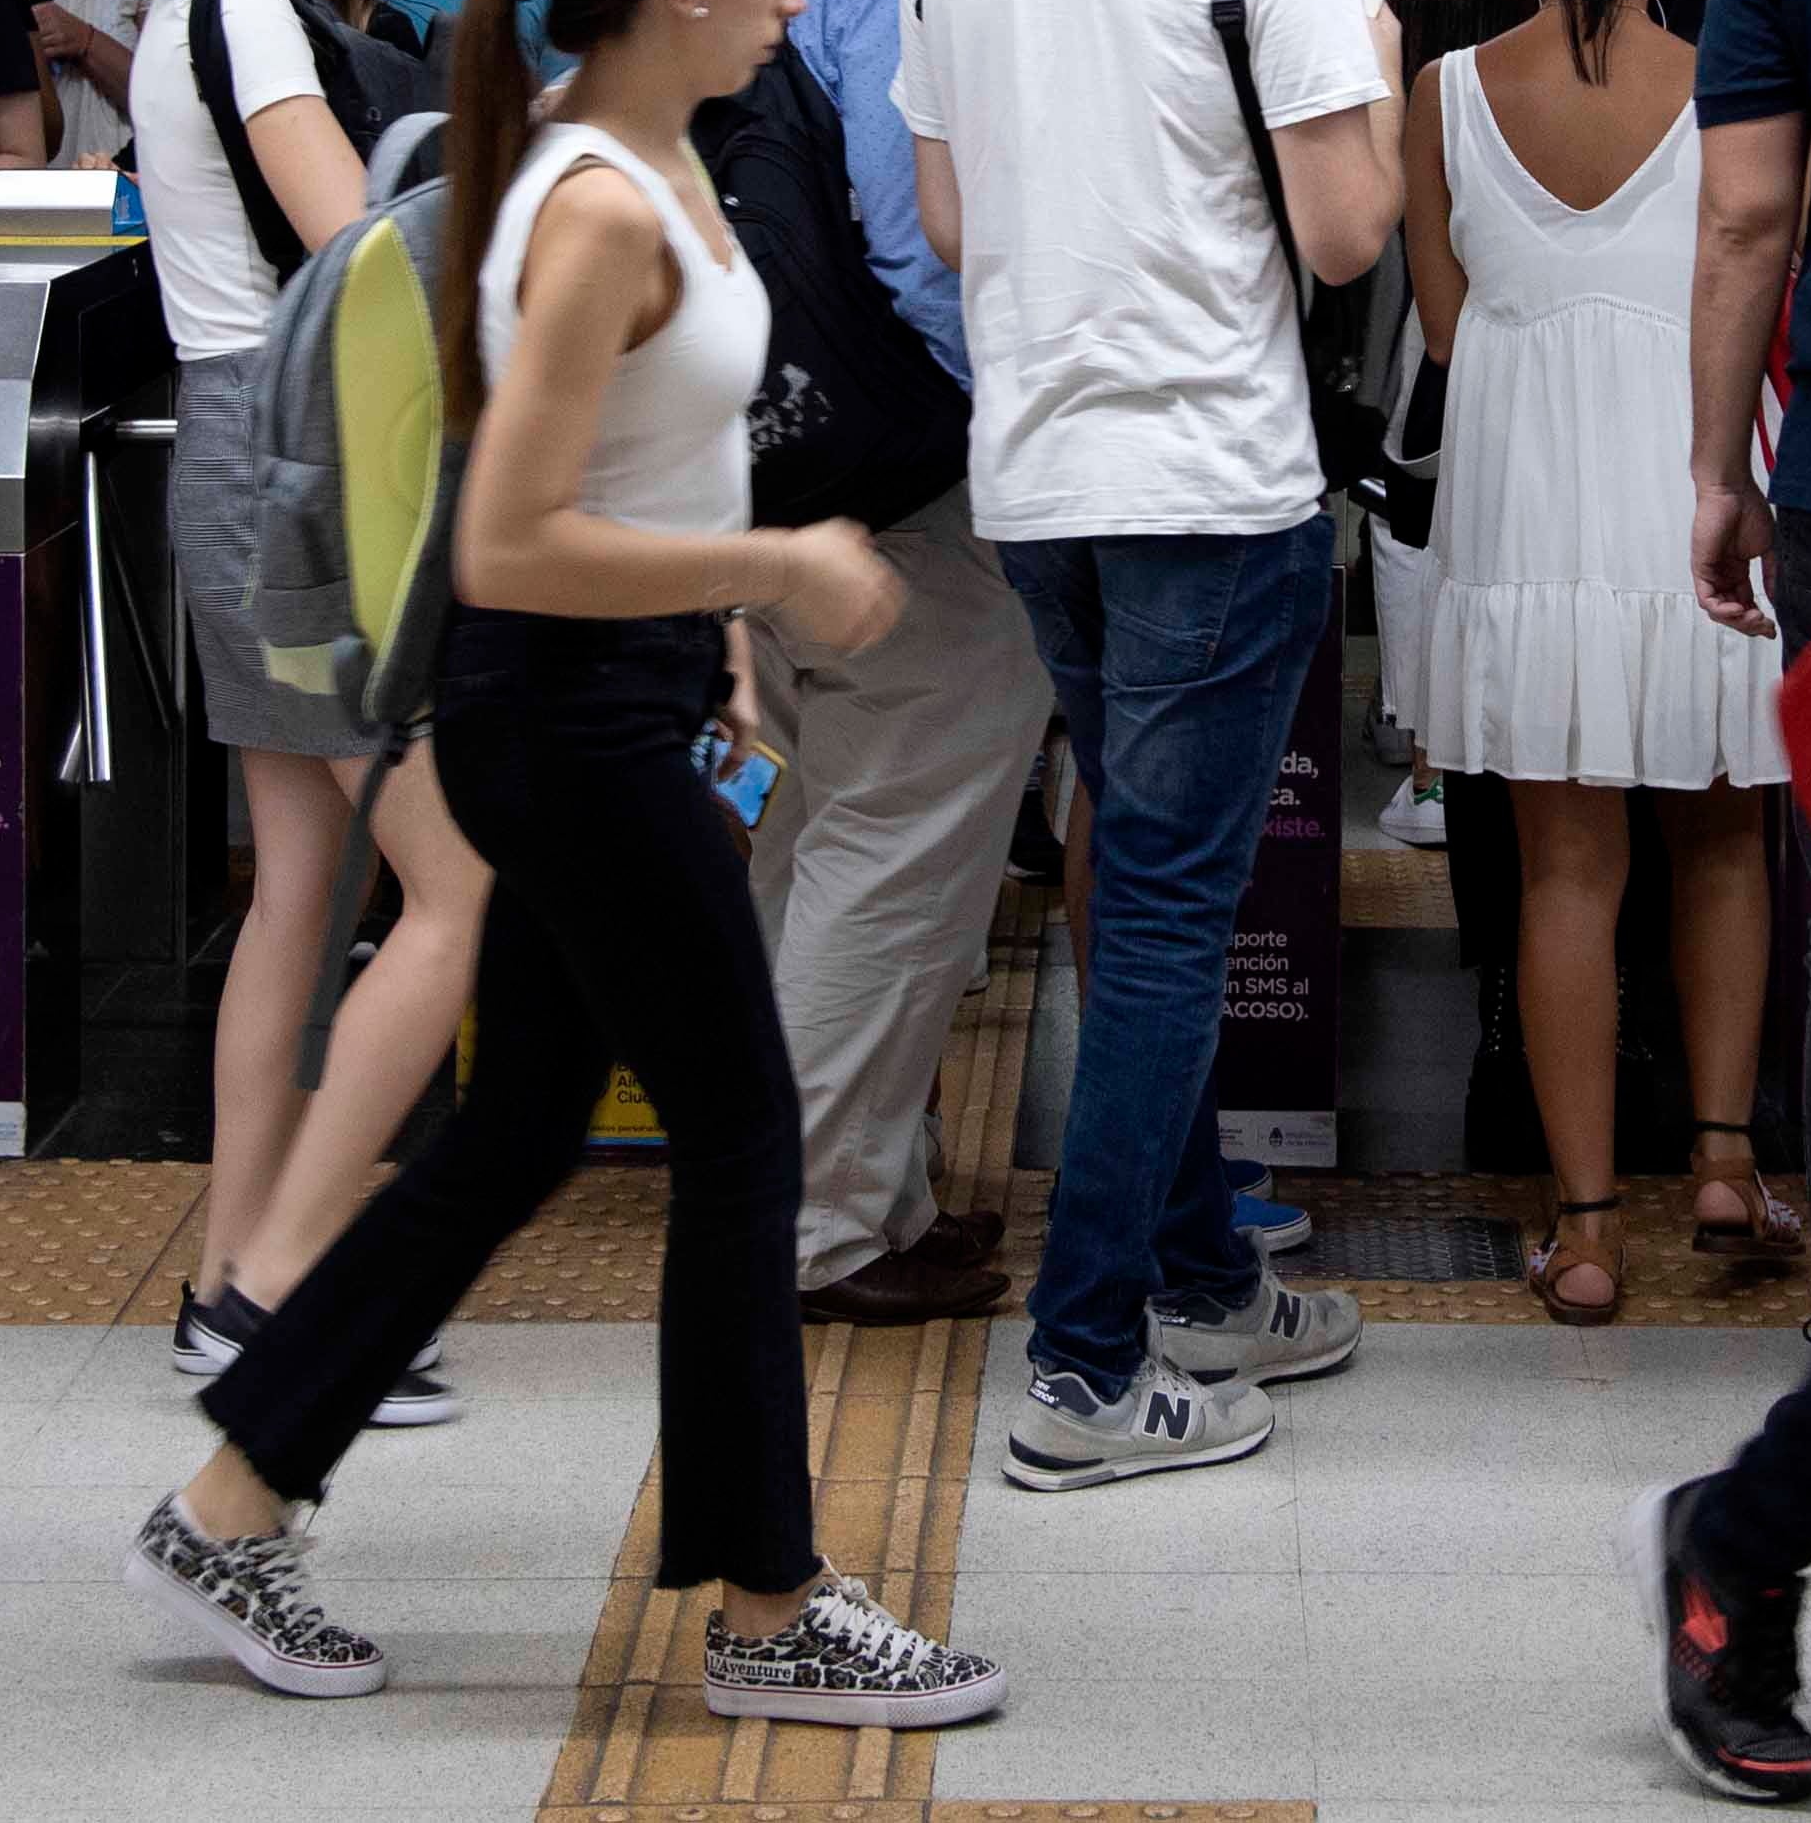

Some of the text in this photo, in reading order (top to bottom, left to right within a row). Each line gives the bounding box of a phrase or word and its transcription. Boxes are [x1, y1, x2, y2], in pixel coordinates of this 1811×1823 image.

[1279, 750, 1319, 779] da,
[1230, 930, 1288, 951] porte
[1245, 977, 1289, 995] SMS
[1292, 976, 1309, 995] al
[1269, 1288, 1301, 1339] N
[1143, 1389, 1191, 1443] N
